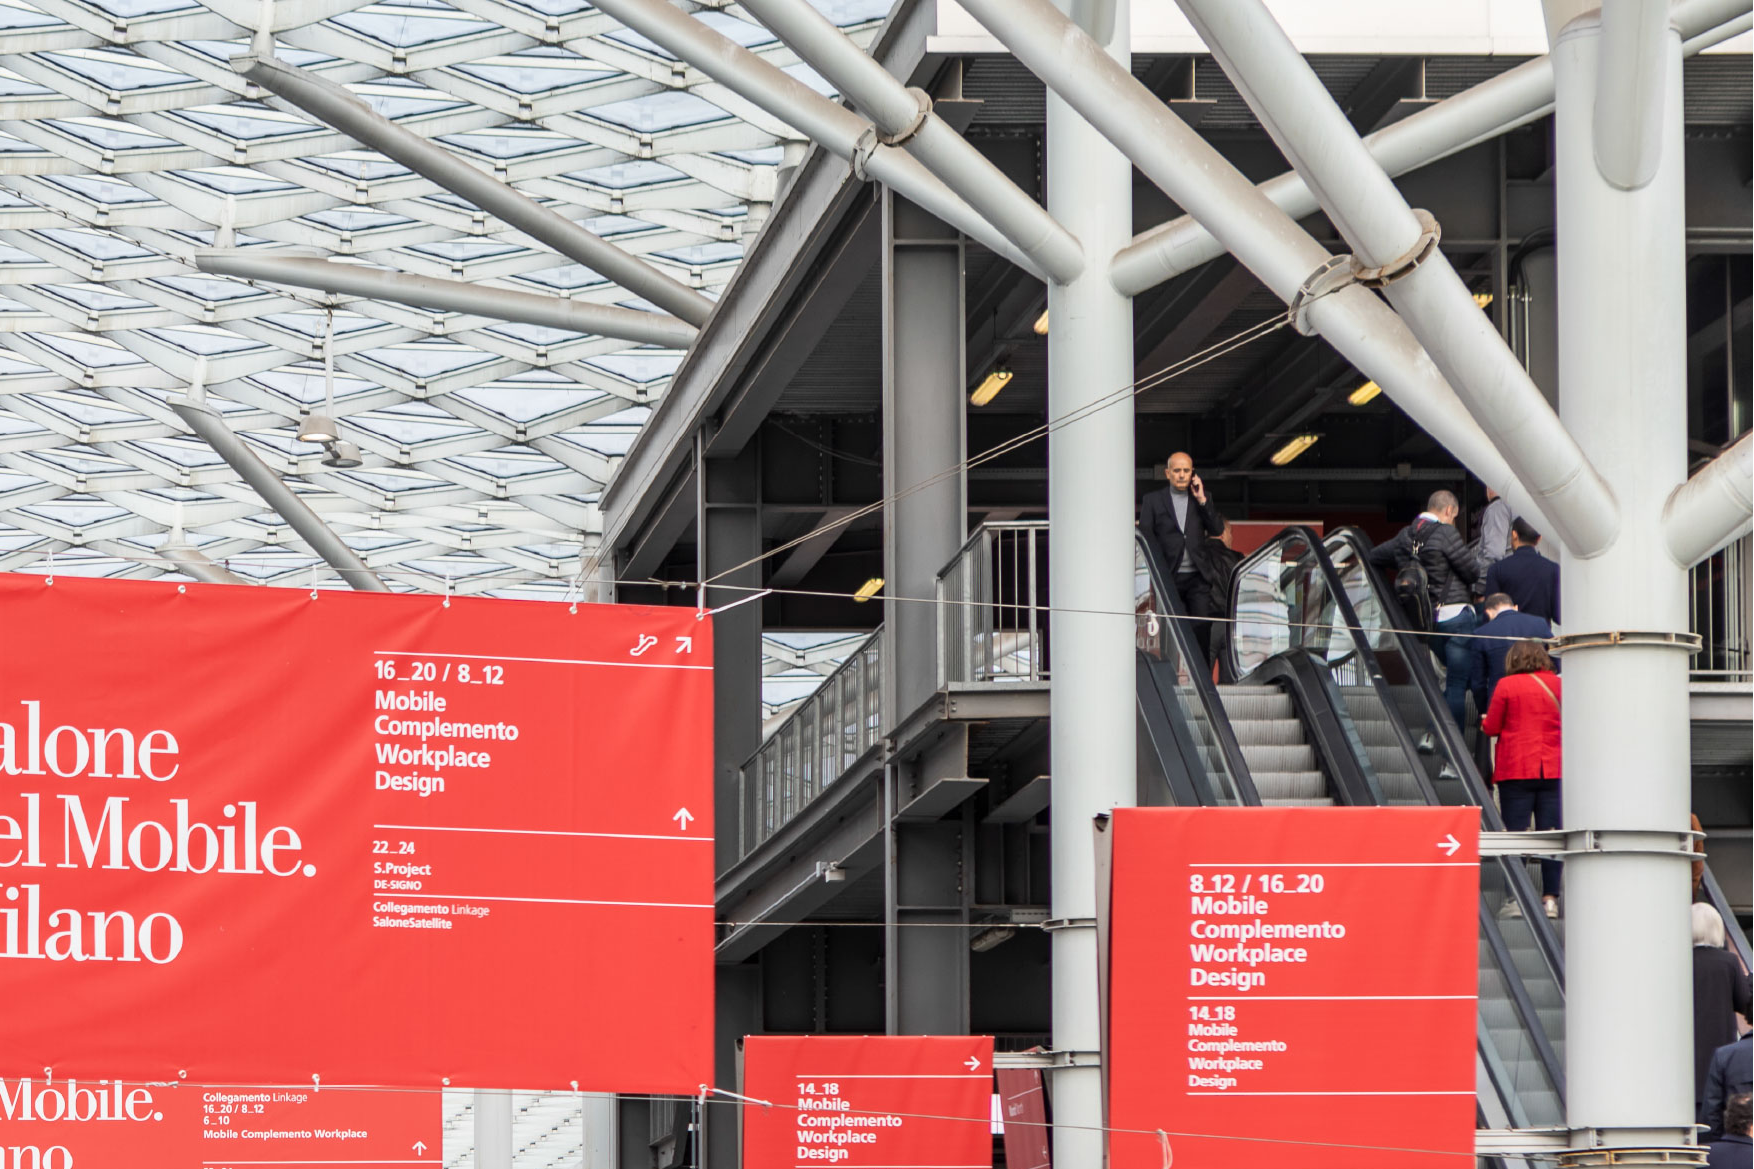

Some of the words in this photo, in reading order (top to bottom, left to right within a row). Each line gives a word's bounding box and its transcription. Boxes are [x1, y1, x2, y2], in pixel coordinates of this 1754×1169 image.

[375, 660, 436, 681] 16_20
[442, 664, 450, 681] /
[458, 664, 503, 684] 8_12
[376, 690, 446, 712] Mobile
[375, 715, 518, 741] Complemento
[375, 743, 490, 771] Workplace
[376, 770, 444, 797] Design
[57, 795, 316, 877] Mobile.
[373, 841, 415, 854] 22_24
[374, 862, 431, 877] S.Project
[374, 880, 422, 890] DE-SIGNO
[1190, 874, 1235, 893] 8_12
[1242, 875, 1251, 893] /
[1259, 874, 1324, 893] 16_20
[373, 902, 449, 918] Collegamento
[452, 905, 490, 918] Linkage
[1192, 895, 1268, 914] Mobile
[373, 916, 452, 929] SaloneSatellite
[1191, 919, 1345, 944] Complemento
[1190, 942, 1307, 967] Workplace
[1191, 966, 1265, 991] Design
[1190, 1006, 1235, 1020] 14_18
[1189, 1023, 1238, 1036] Mobile
[1188, 1039, 1286, 1055] Complemento
[1189, 1057, 1263, 1072] Workplace
[798, 1083, 839, 1094] 14_18
[1189, 1074, 1236, 1090] Design
[203, 1093, 270, 1105] Collegamento
[273, 1093, 307, 1104] Linkage
[798, 1098, 850, 1111] Mobile
[204, 1103, 232, 1113] 16_20
[234, 1104, 238, 1113] /
[242, 1104, 264, 1113] 8_12
[204, 1116, 229, 1125] 6_10
[798, 1112, 904, 1130] Complemento
[204, 1130, 238, 1138] Mobile
[241, 1129, 312, 1140] Complemento
[314, 1129, 367, 1140] Workplace
[797, 1129, 876, 1147] Workplace
[798, 1145, 848, 1162] Design
